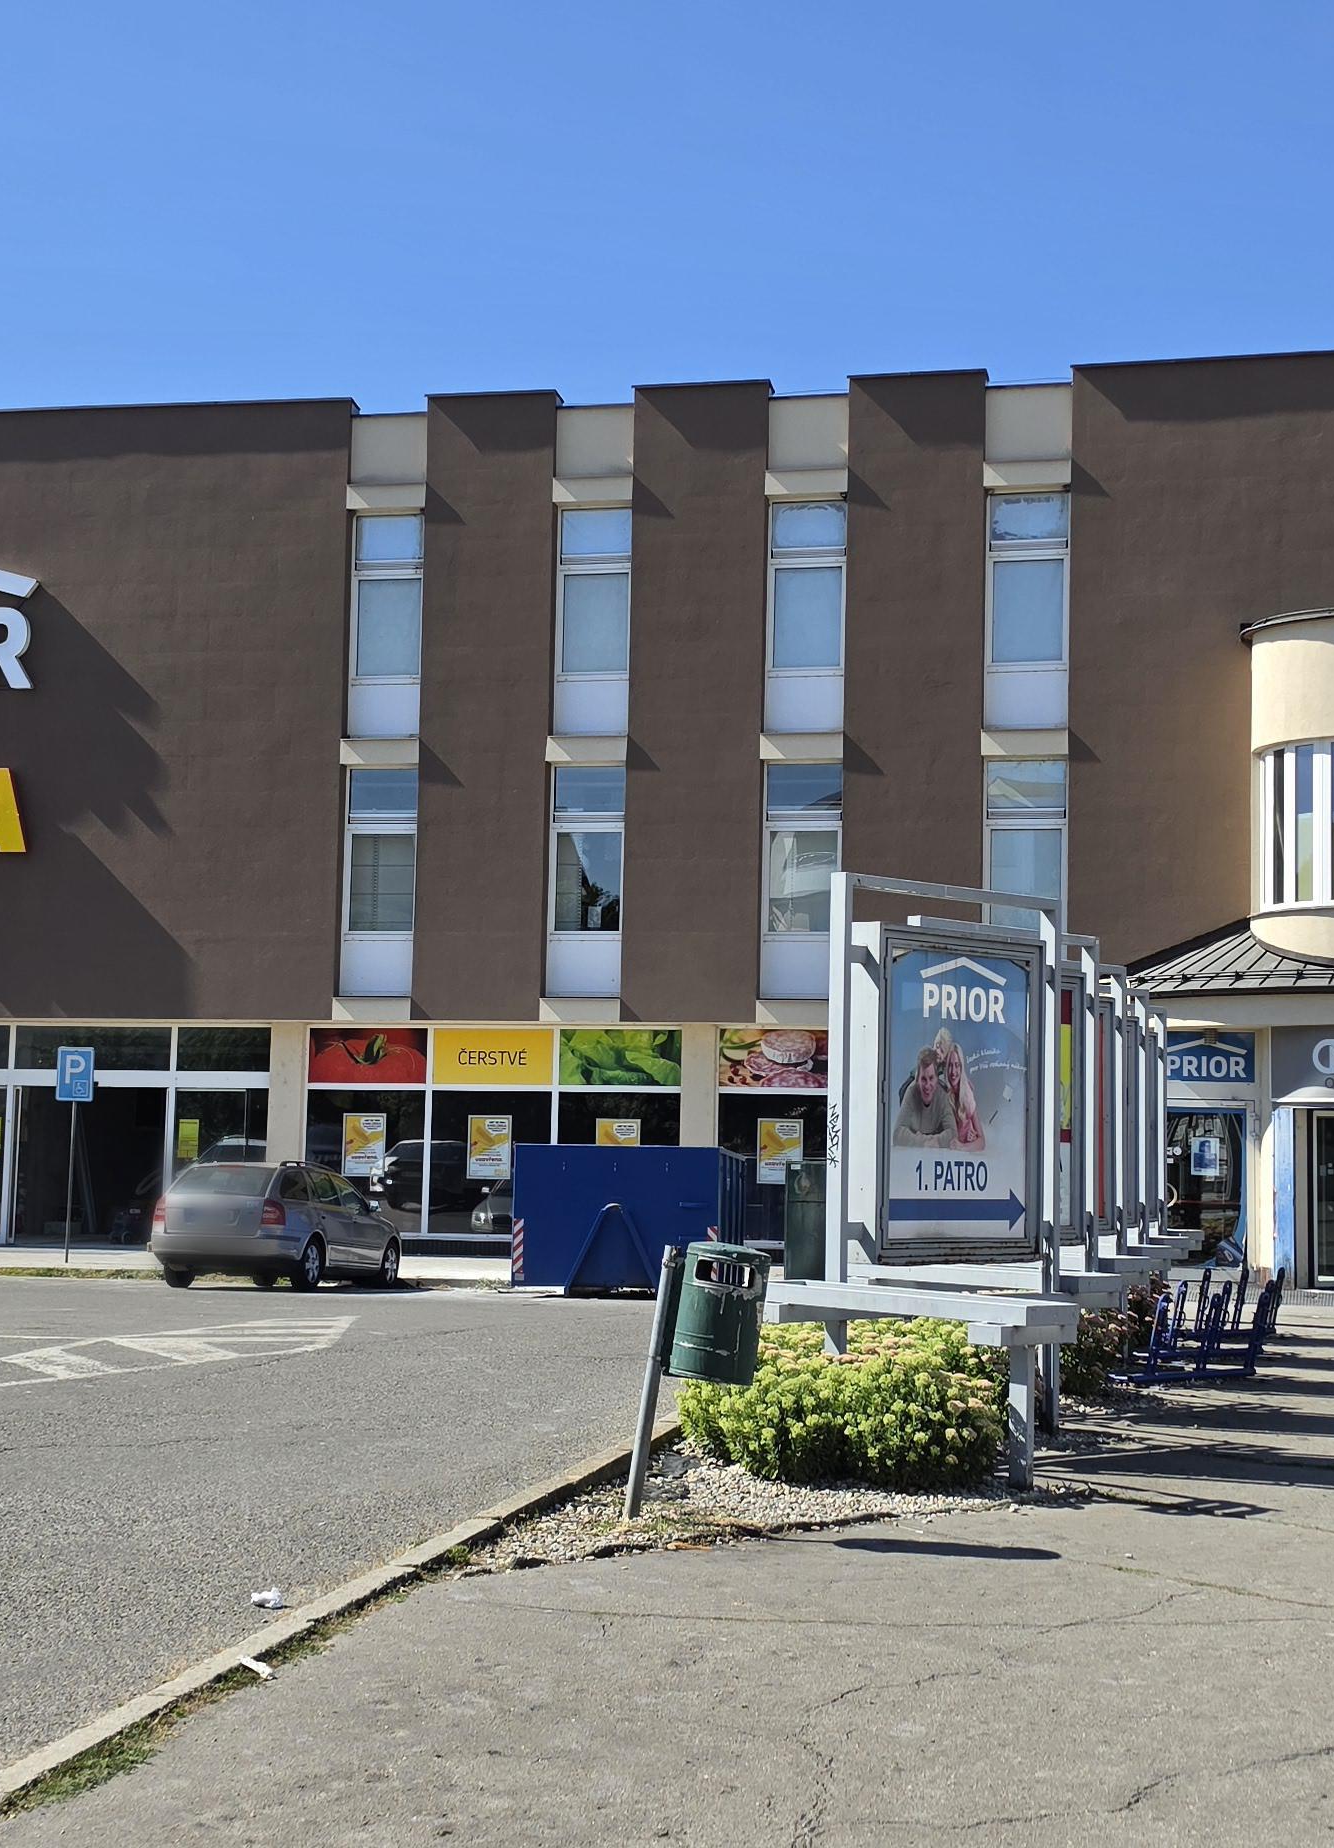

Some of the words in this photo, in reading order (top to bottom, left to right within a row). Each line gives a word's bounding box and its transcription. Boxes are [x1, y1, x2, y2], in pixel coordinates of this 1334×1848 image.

[922, 982, 1006, 1024] PRIOR
[65, 1054, 86, 1084] P
[457, 1047, 528, 1067] ČERSTVÉ
[1167, 1055, 1247, 1079] PRIOR
[915, 1161, 929, 1191] 1.
[934, 1159, 989, 1191] PATRO
